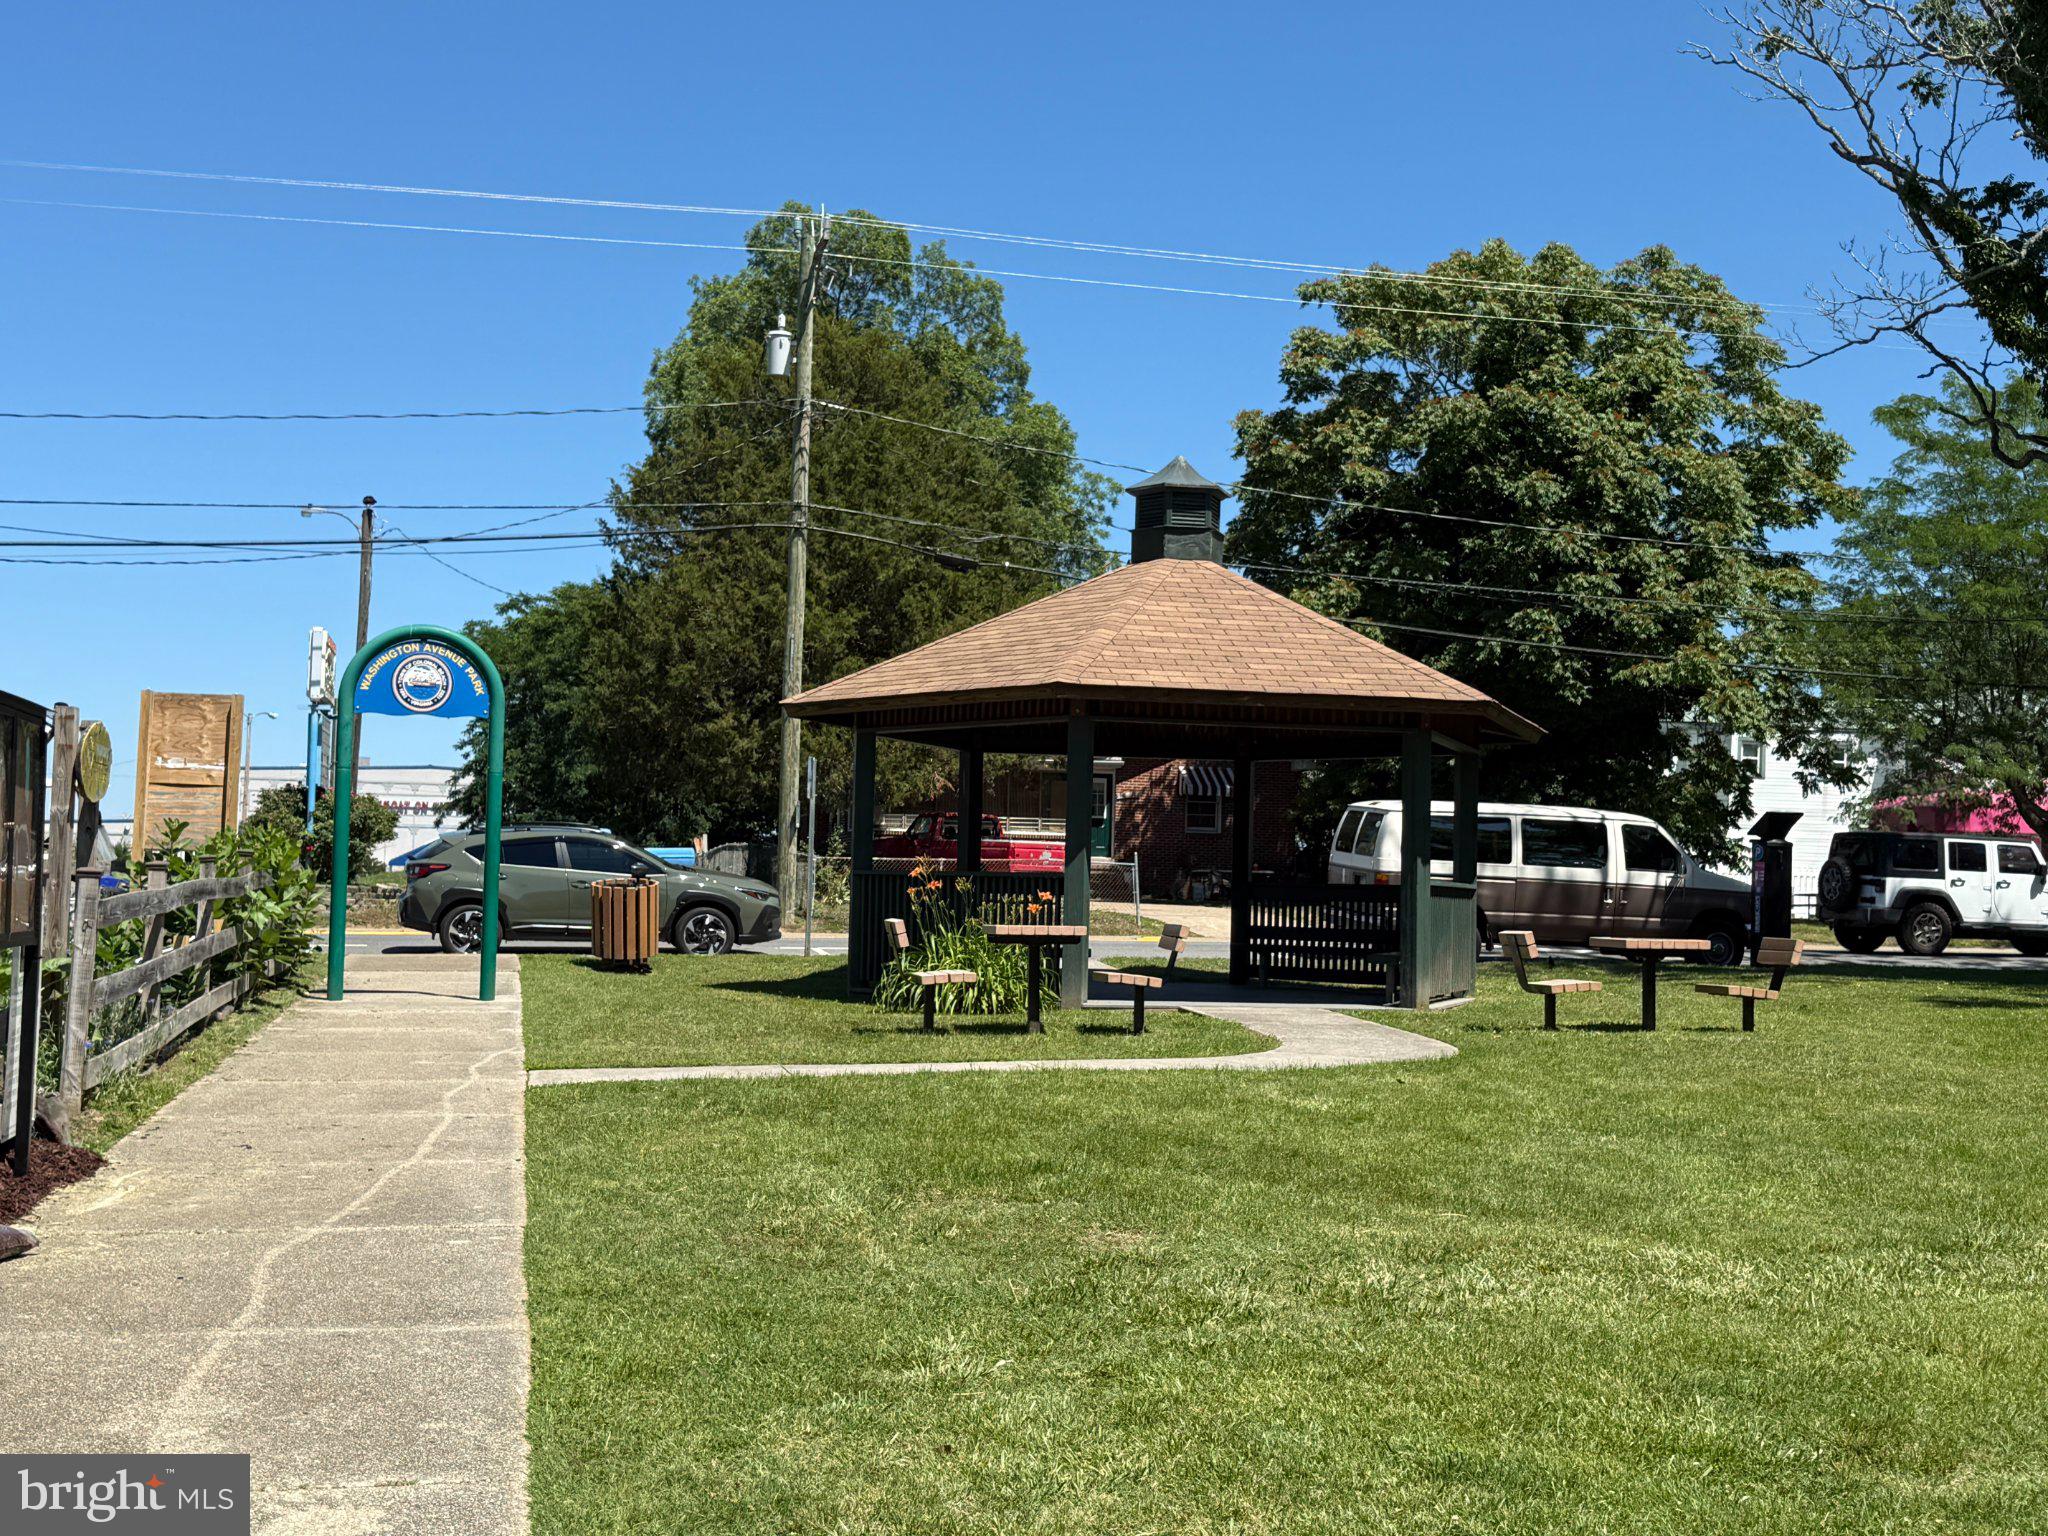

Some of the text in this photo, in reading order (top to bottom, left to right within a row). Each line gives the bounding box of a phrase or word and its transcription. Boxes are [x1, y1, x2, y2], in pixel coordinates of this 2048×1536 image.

[360, 643, 420, 690] WASHINGTON
[423, 643, 467, 668] AVENUE
[465, 666, 485, 696] PARK
